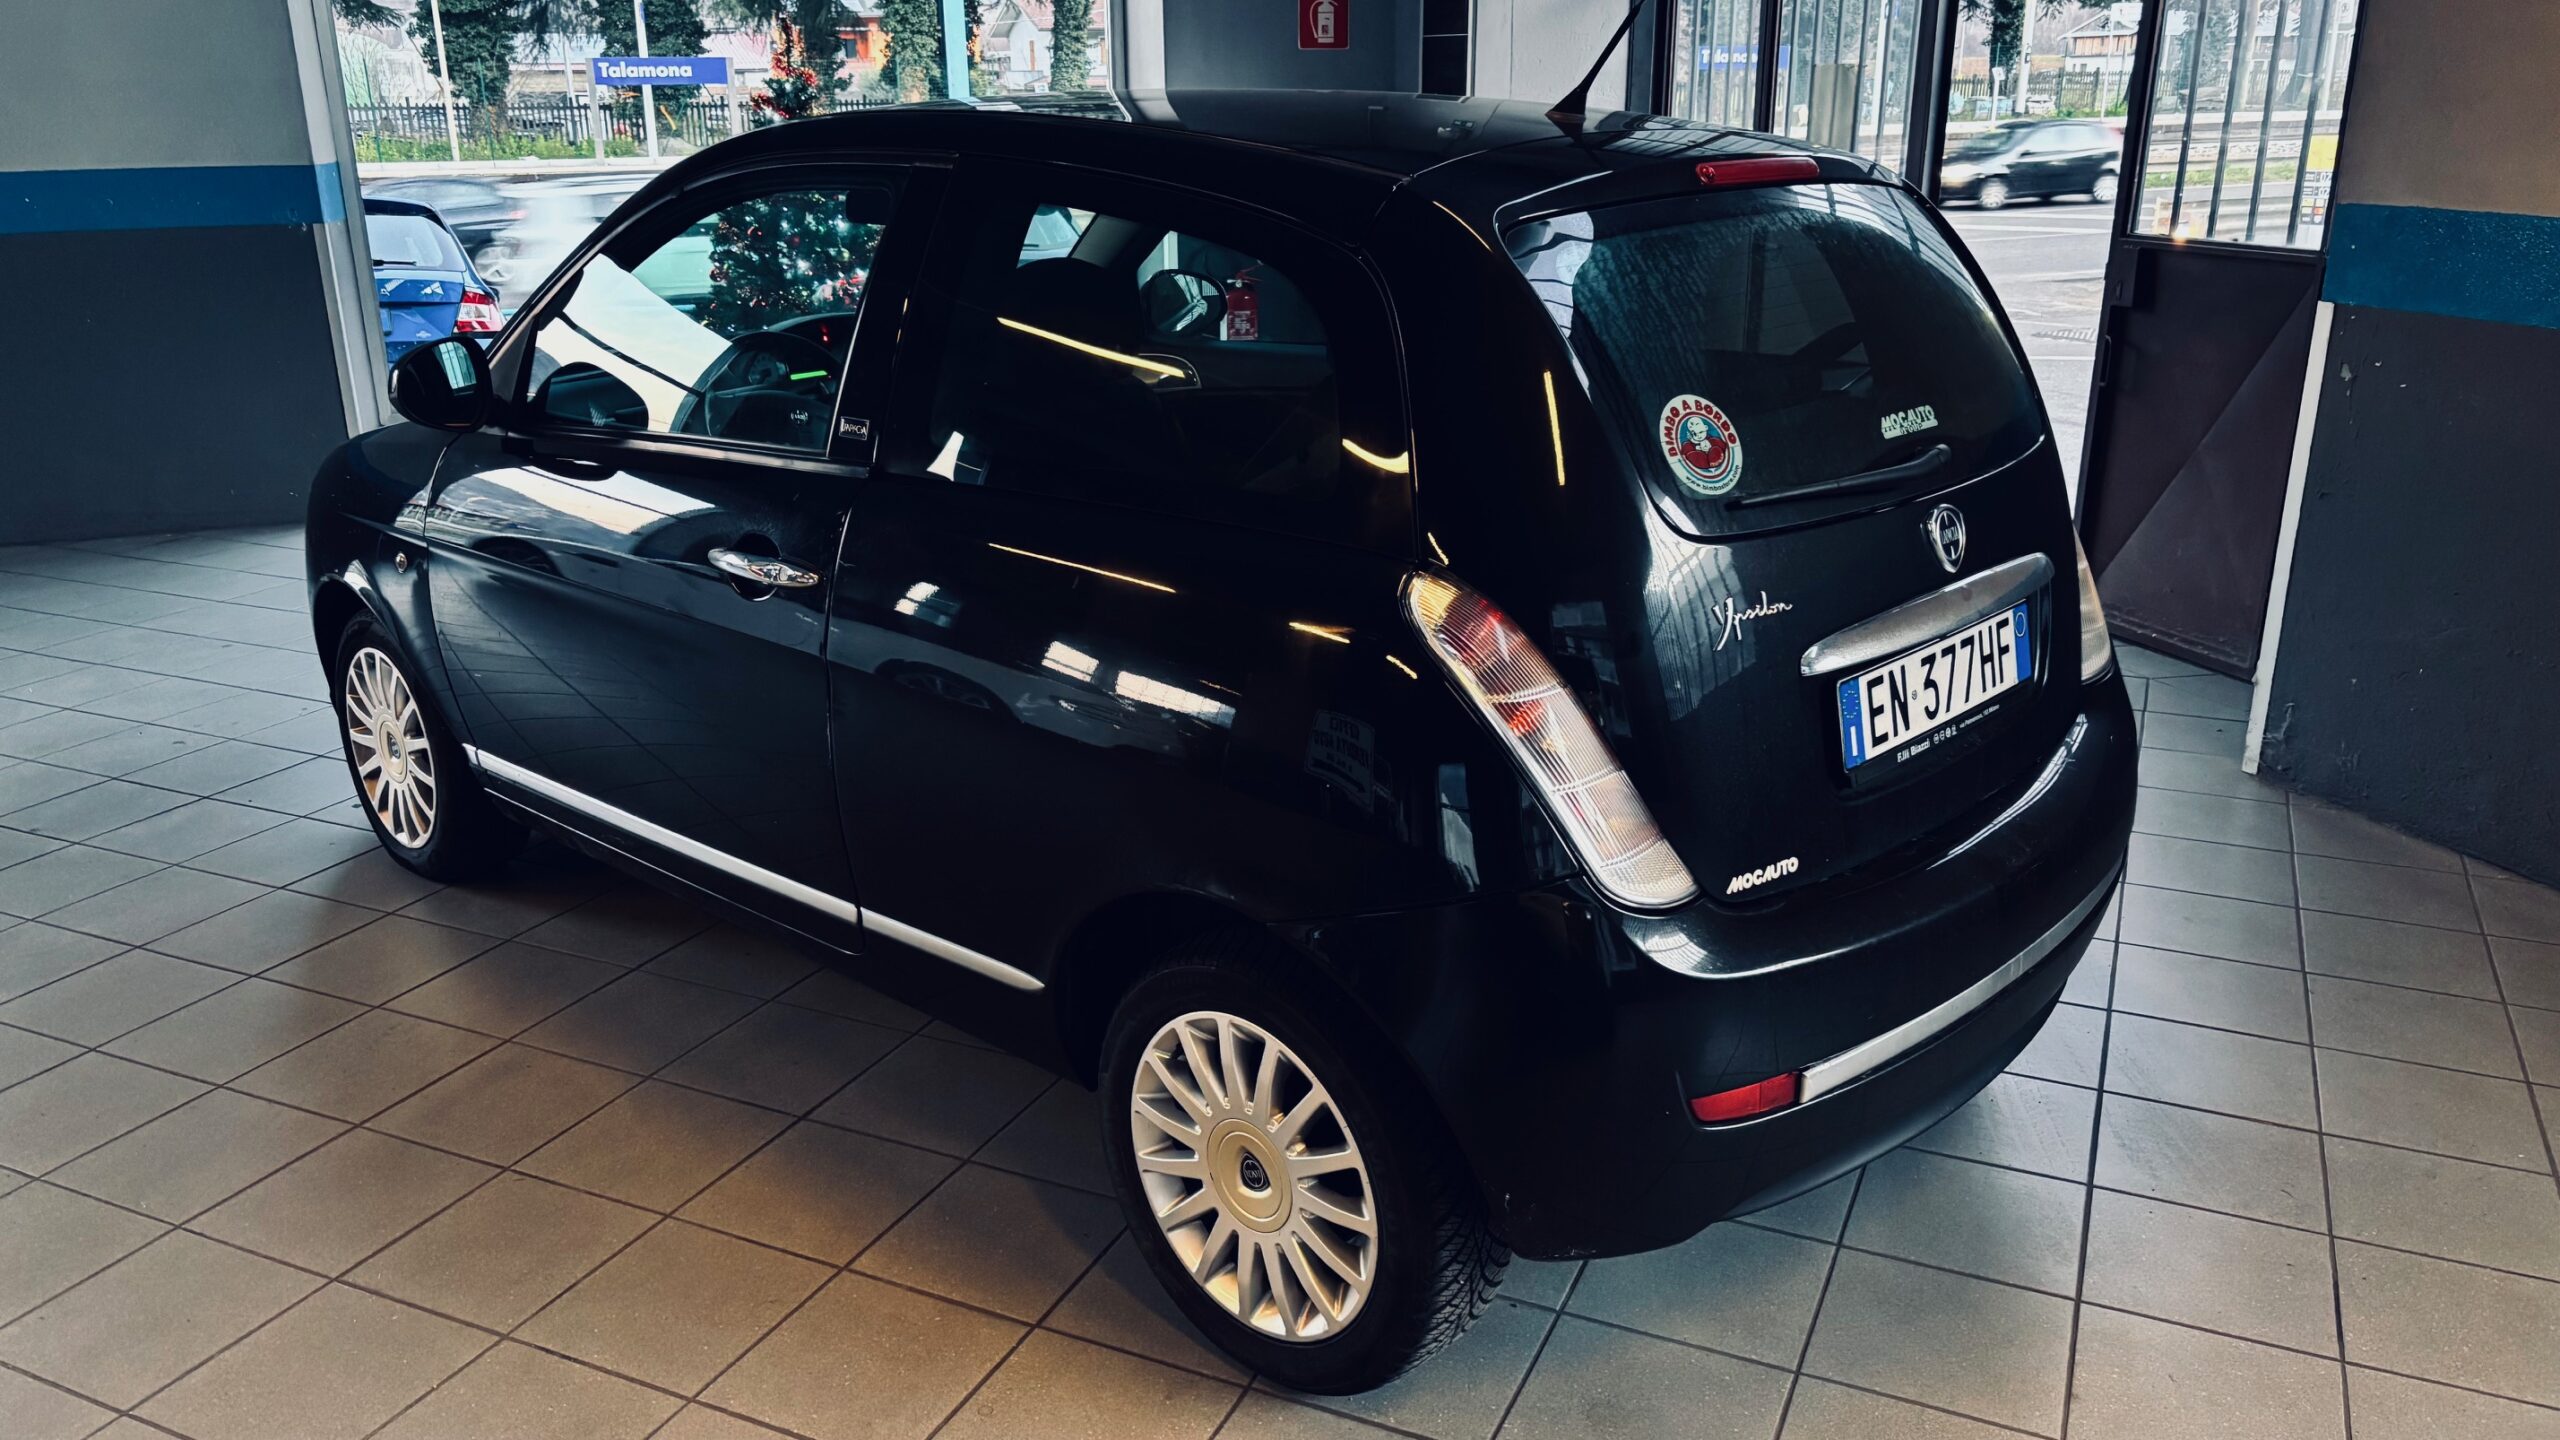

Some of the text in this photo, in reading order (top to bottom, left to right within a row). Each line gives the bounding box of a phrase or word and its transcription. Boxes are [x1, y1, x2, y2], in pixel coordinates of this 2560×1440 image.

[597, 61, 693, 78] Talamona
[1664, 399, 1737, 457] BIMBO A BORDO
[1880, 404, 1935, 429] MOCAUTO
[1712, 590, 1793, 651] Ypsilon
[1866, 616, 2010, 748] EN 377HF
[1726, 856, 1799, 895] MOCAUTO
